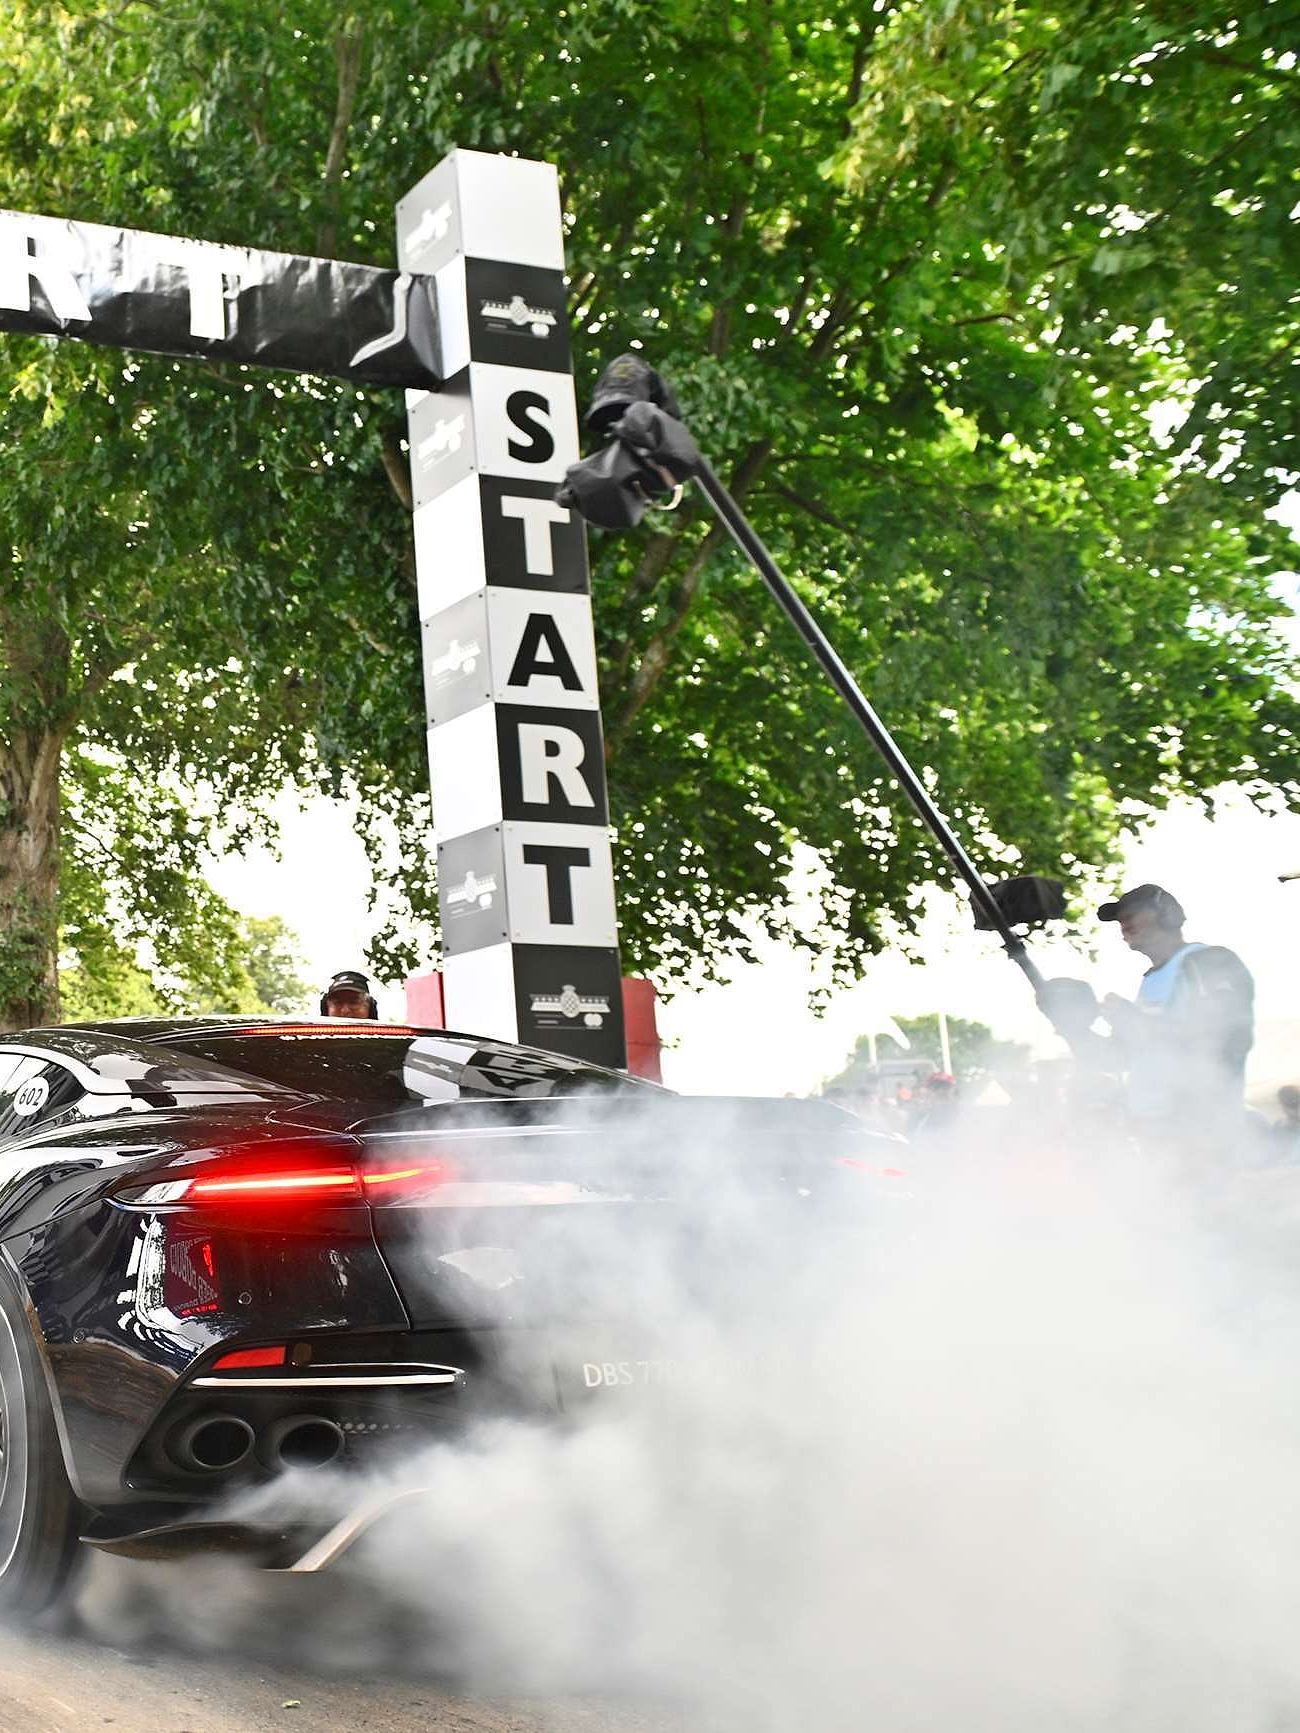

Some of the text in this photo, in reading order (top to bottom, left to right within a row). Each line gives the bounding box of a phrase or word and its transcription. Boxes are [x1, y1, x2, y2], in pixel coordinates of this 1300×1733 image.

[501, 390, 595, 926] START
[19, 1088, 43, 1105] 602
[582, 1361, 634, 1387] DBS
